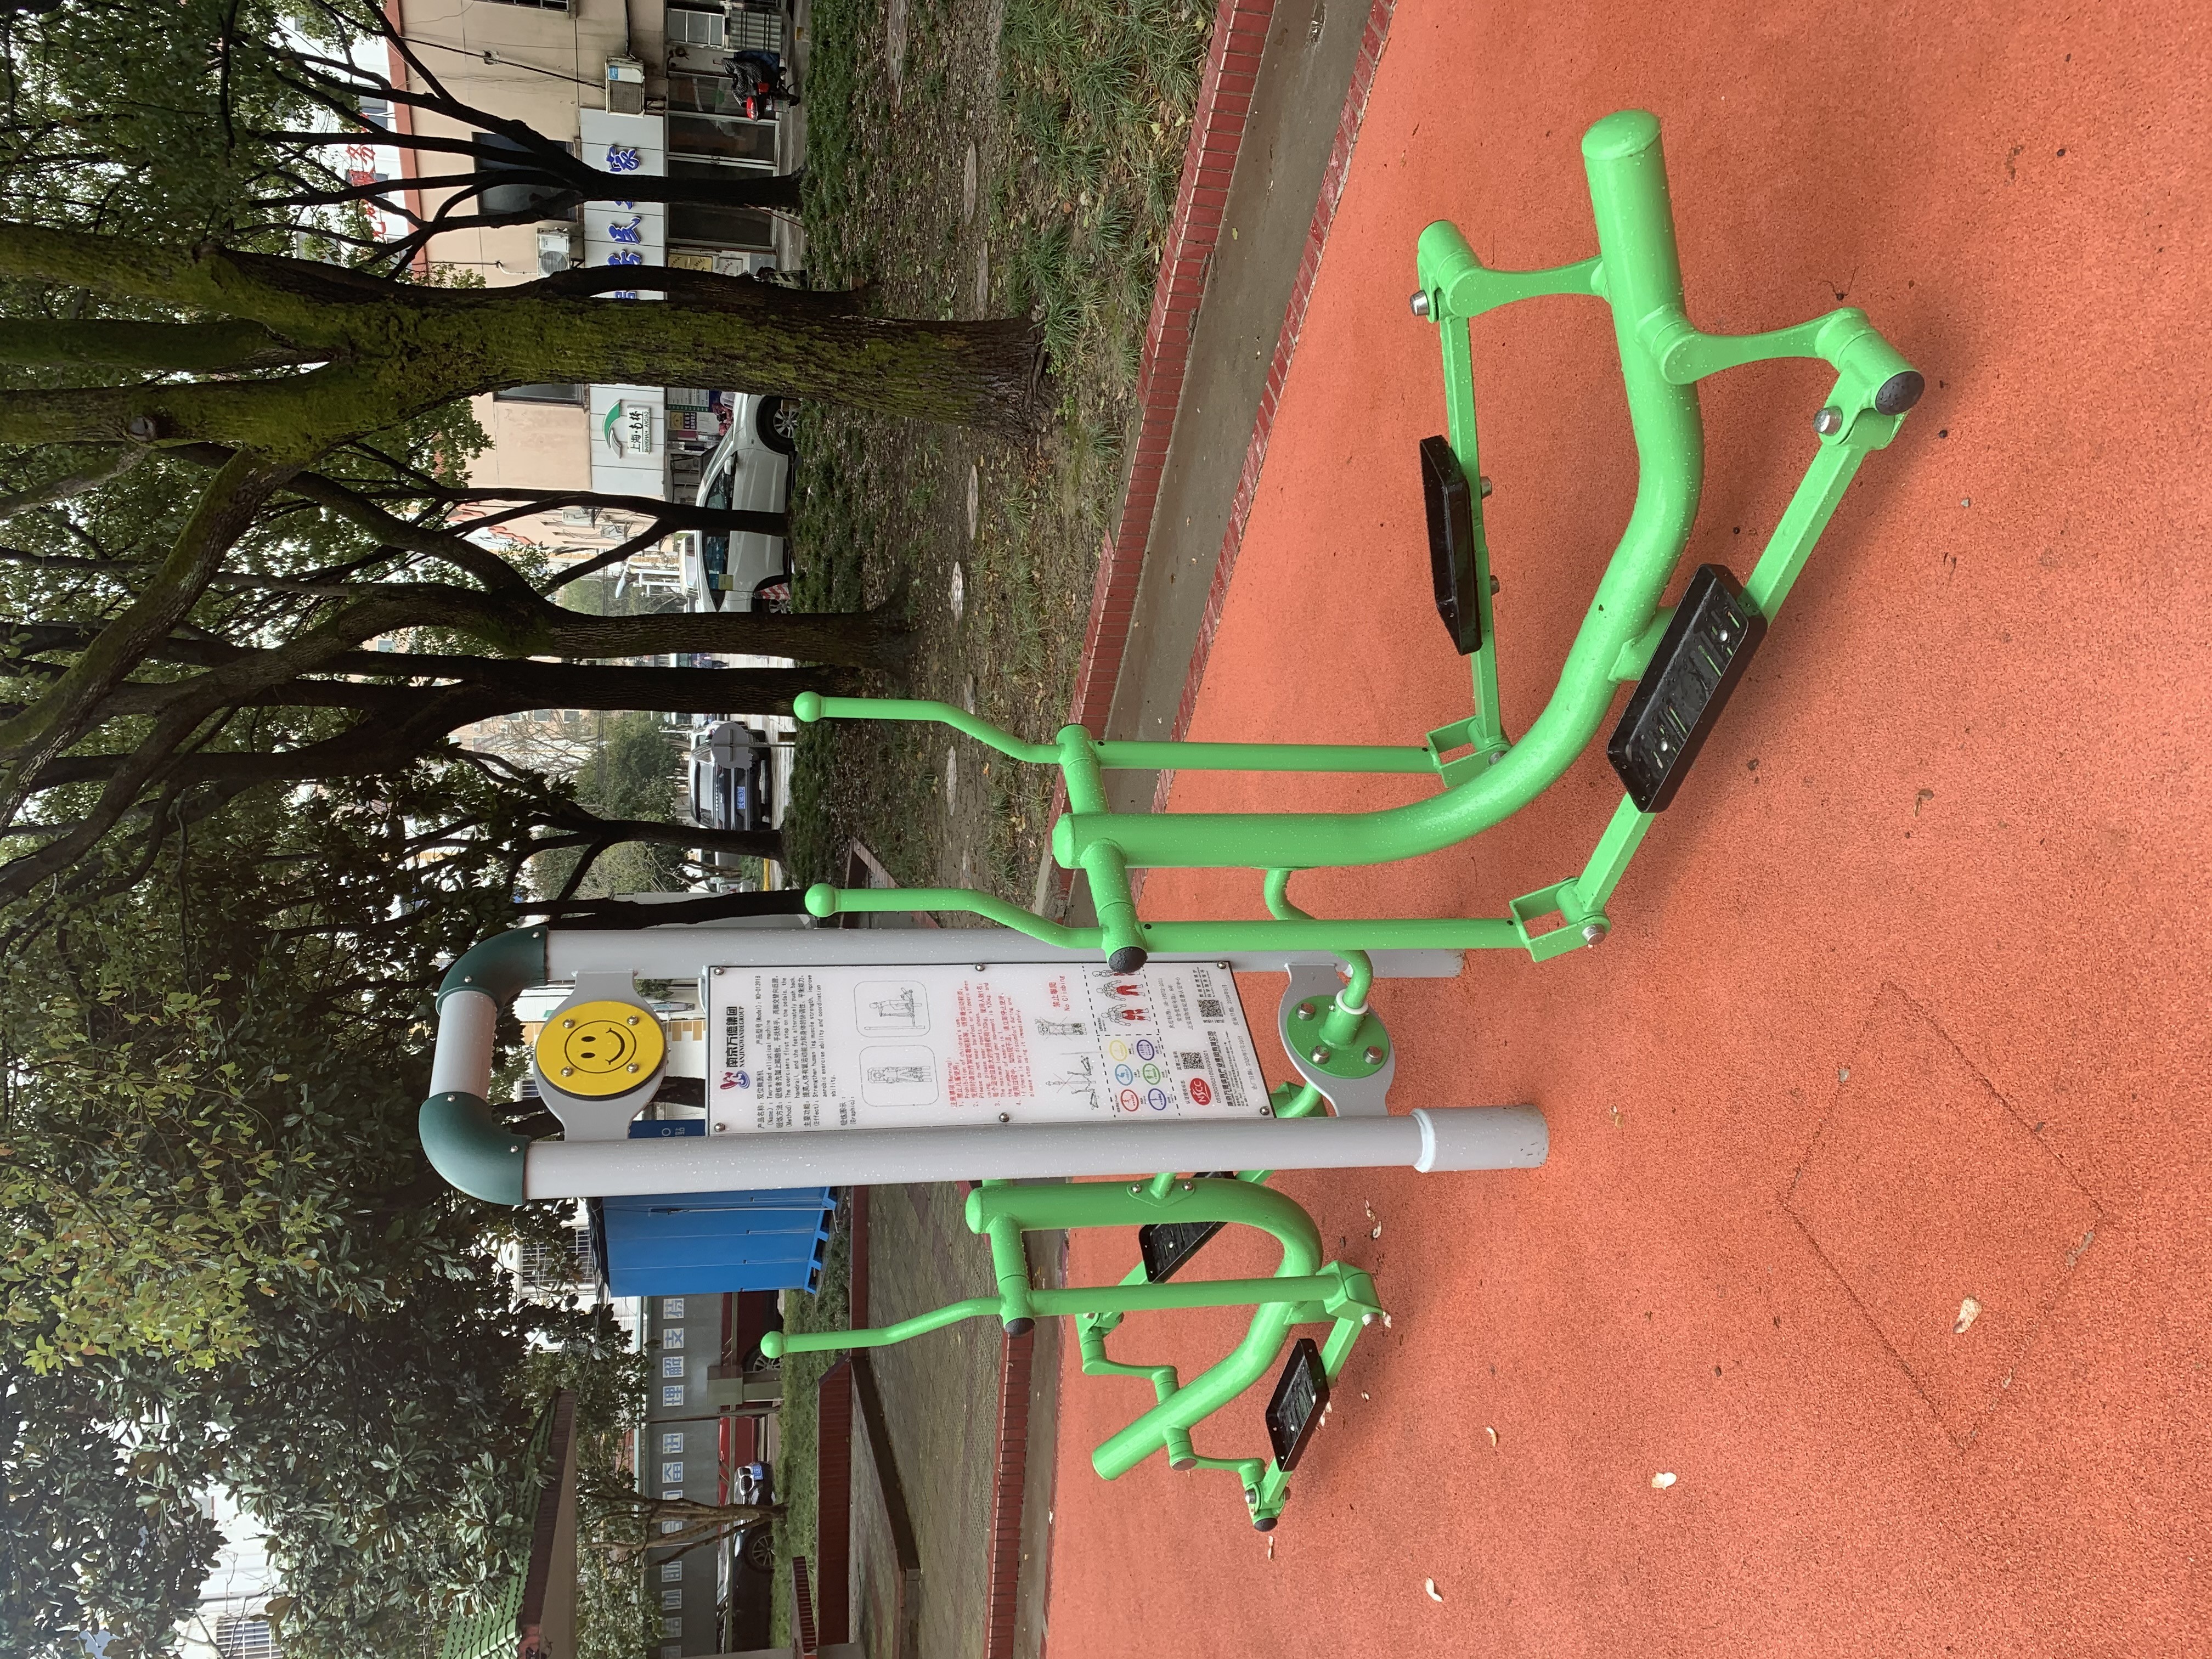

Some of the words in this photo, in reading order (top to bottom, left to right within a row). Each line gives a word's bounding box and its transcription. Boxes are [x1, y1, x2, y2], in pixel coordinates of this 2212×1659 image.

[1048, 981, 1060, 1007] 禁止攀爬
[1059, 975, 1068, 1001] Climbing
[726, 1007, 738, 1068] 南京万德集团
[1012, 1026, 1020, 1052] discomfort
[1172, 1051, 1182, 1070] 监管二维码
[1207, 1031, 1234, 1107] 南京万德体育产业集团有限公司
[961, 1067, 970, 1098] Prohibition
[1193, 1080, 1207, 1102] NSCC
[664, 1300, 682, 1405] 理解支持
